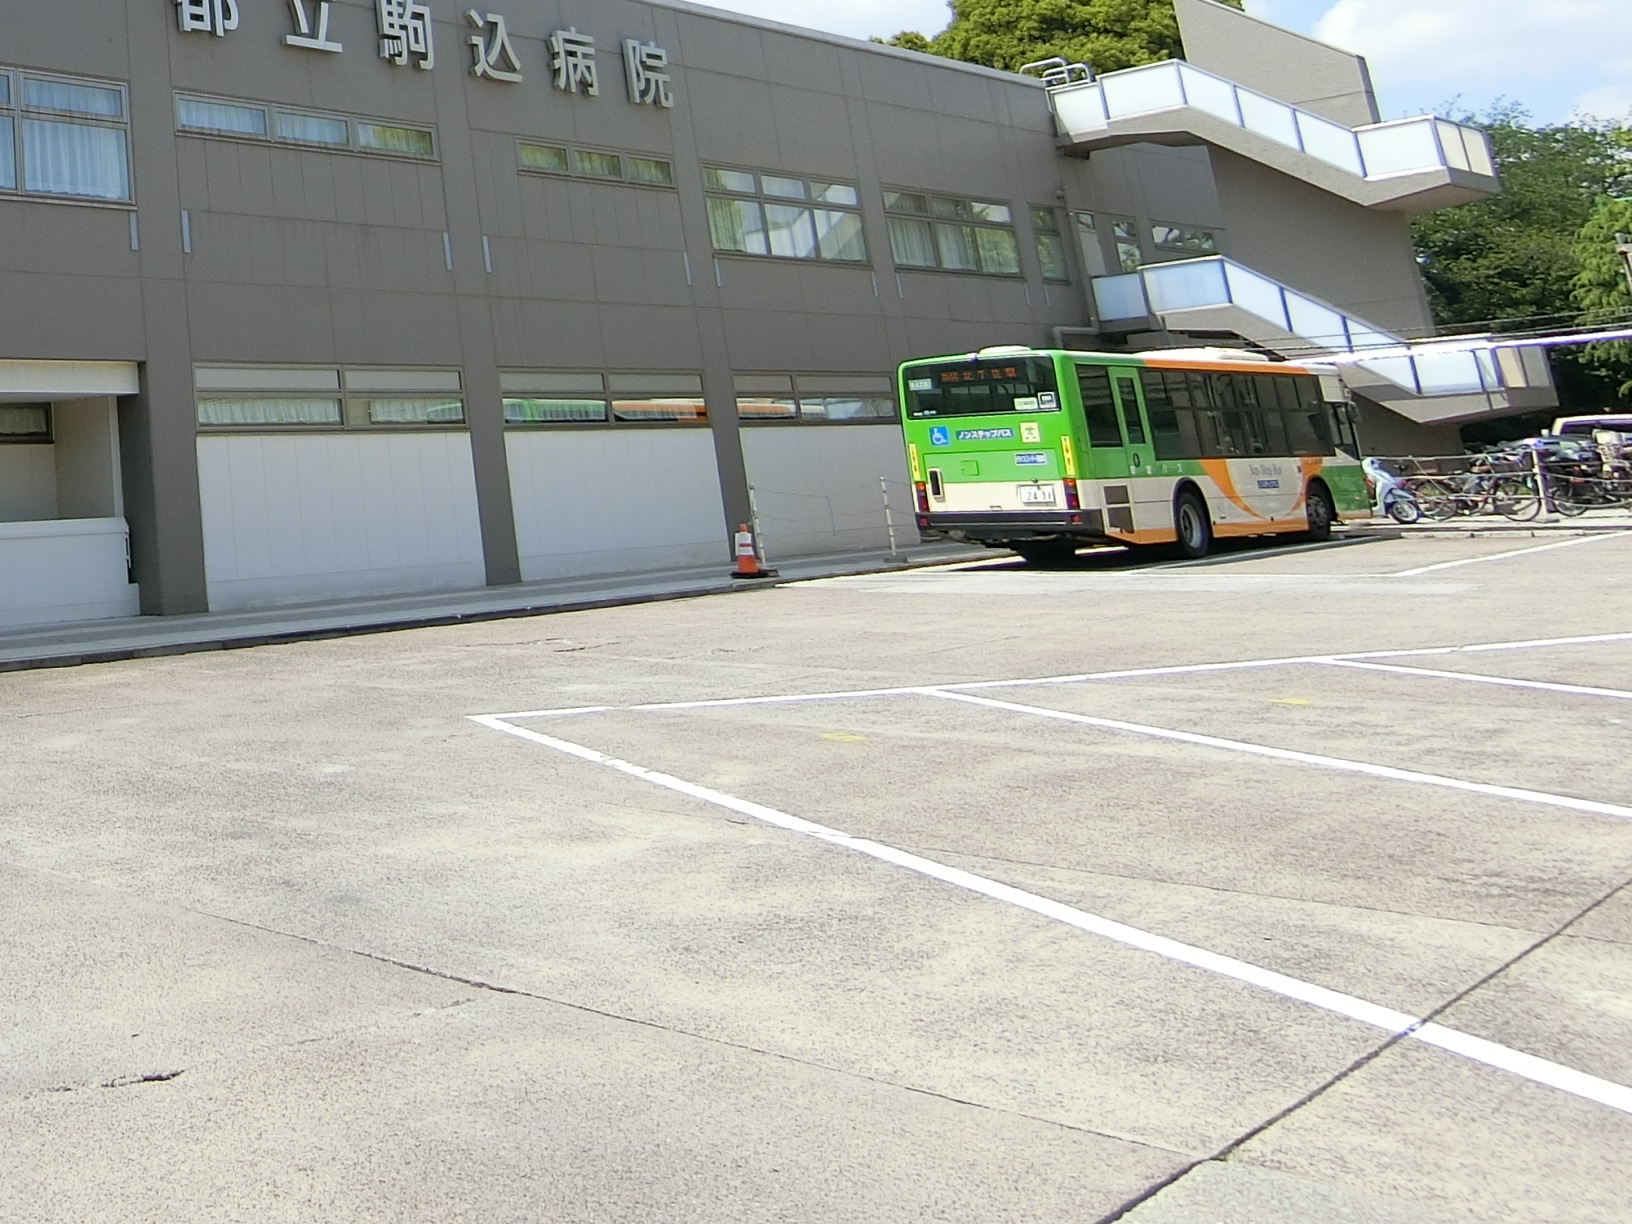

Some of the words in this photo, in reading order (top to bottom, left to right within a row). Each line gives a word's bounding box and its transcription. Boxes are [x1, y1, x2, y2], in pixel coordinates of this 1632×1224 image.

[958, 428, 1013, 440] ノンステップバス
